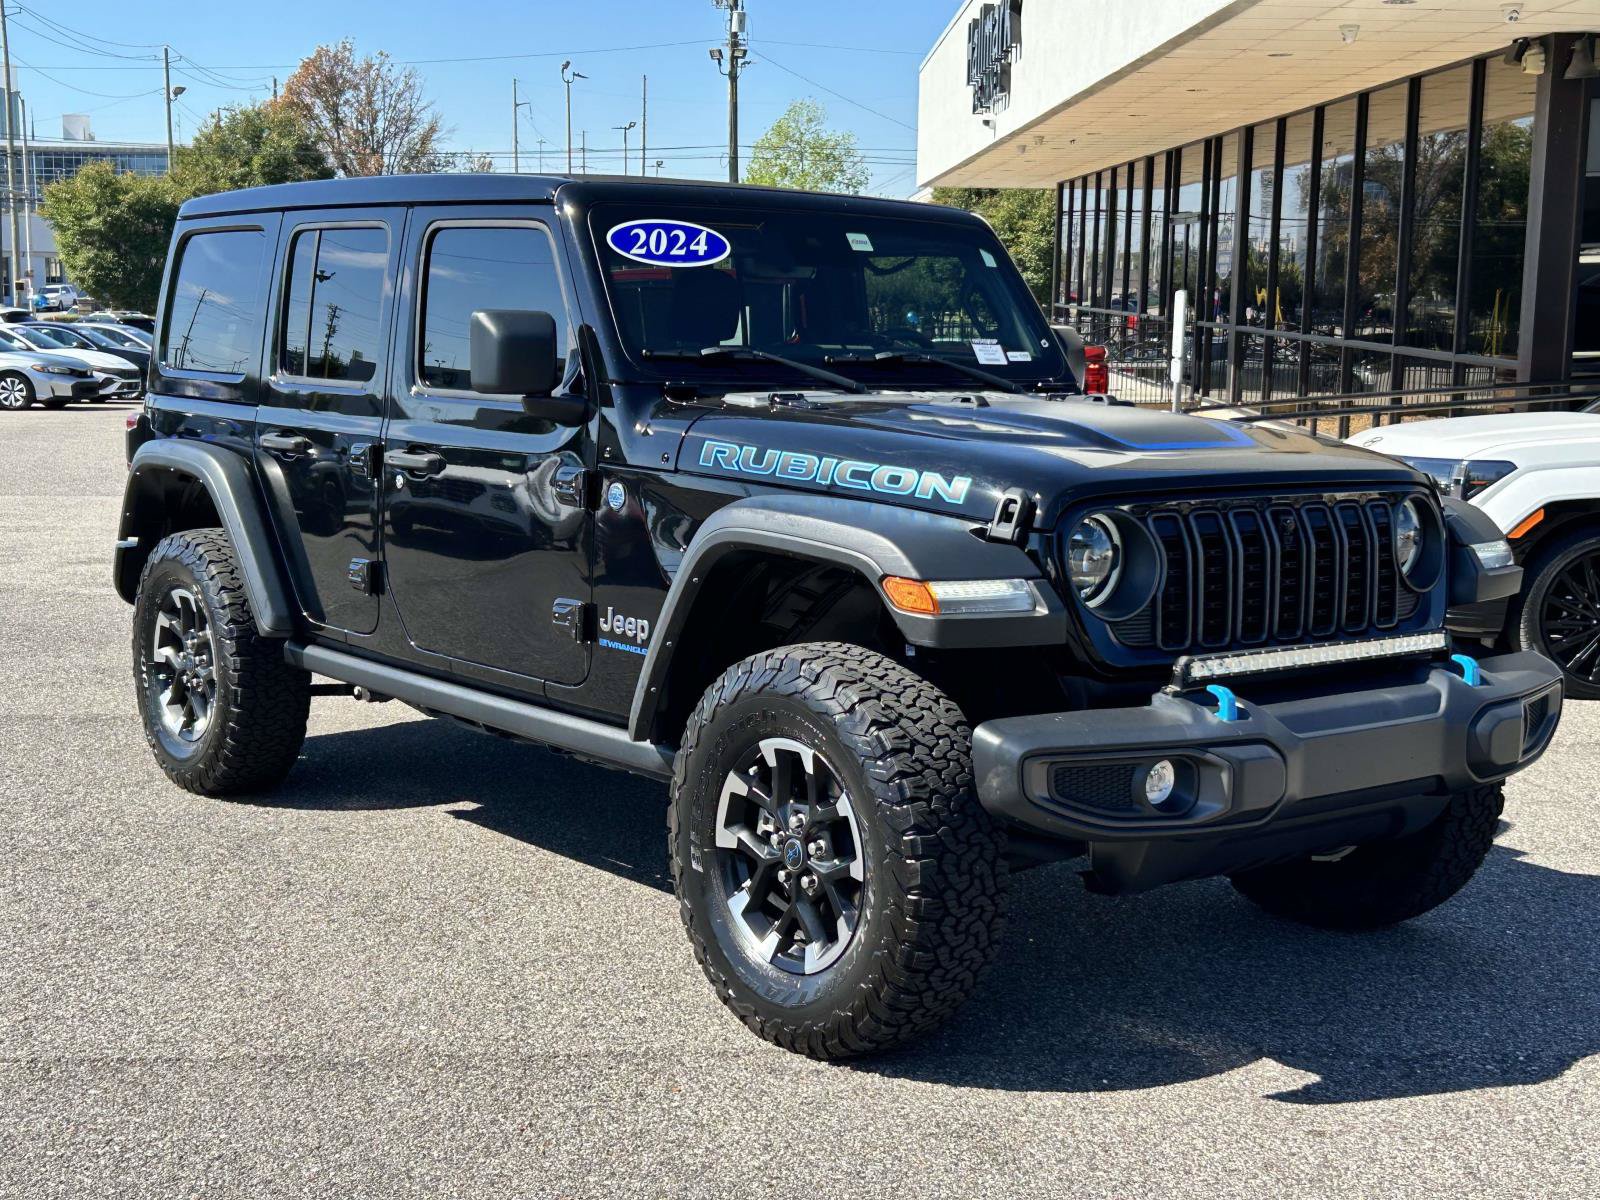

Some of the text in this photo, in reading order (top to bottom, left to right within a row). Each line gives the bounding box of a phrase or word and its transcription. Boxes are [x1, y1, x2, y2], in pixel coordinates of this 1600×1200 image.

[629, 228, 708, 256] 2024
[699, 440, 972, 505] RUBICON
[600, 606, 649, 644] Jeep
[607, 640, 650, 656] WRANGLE
